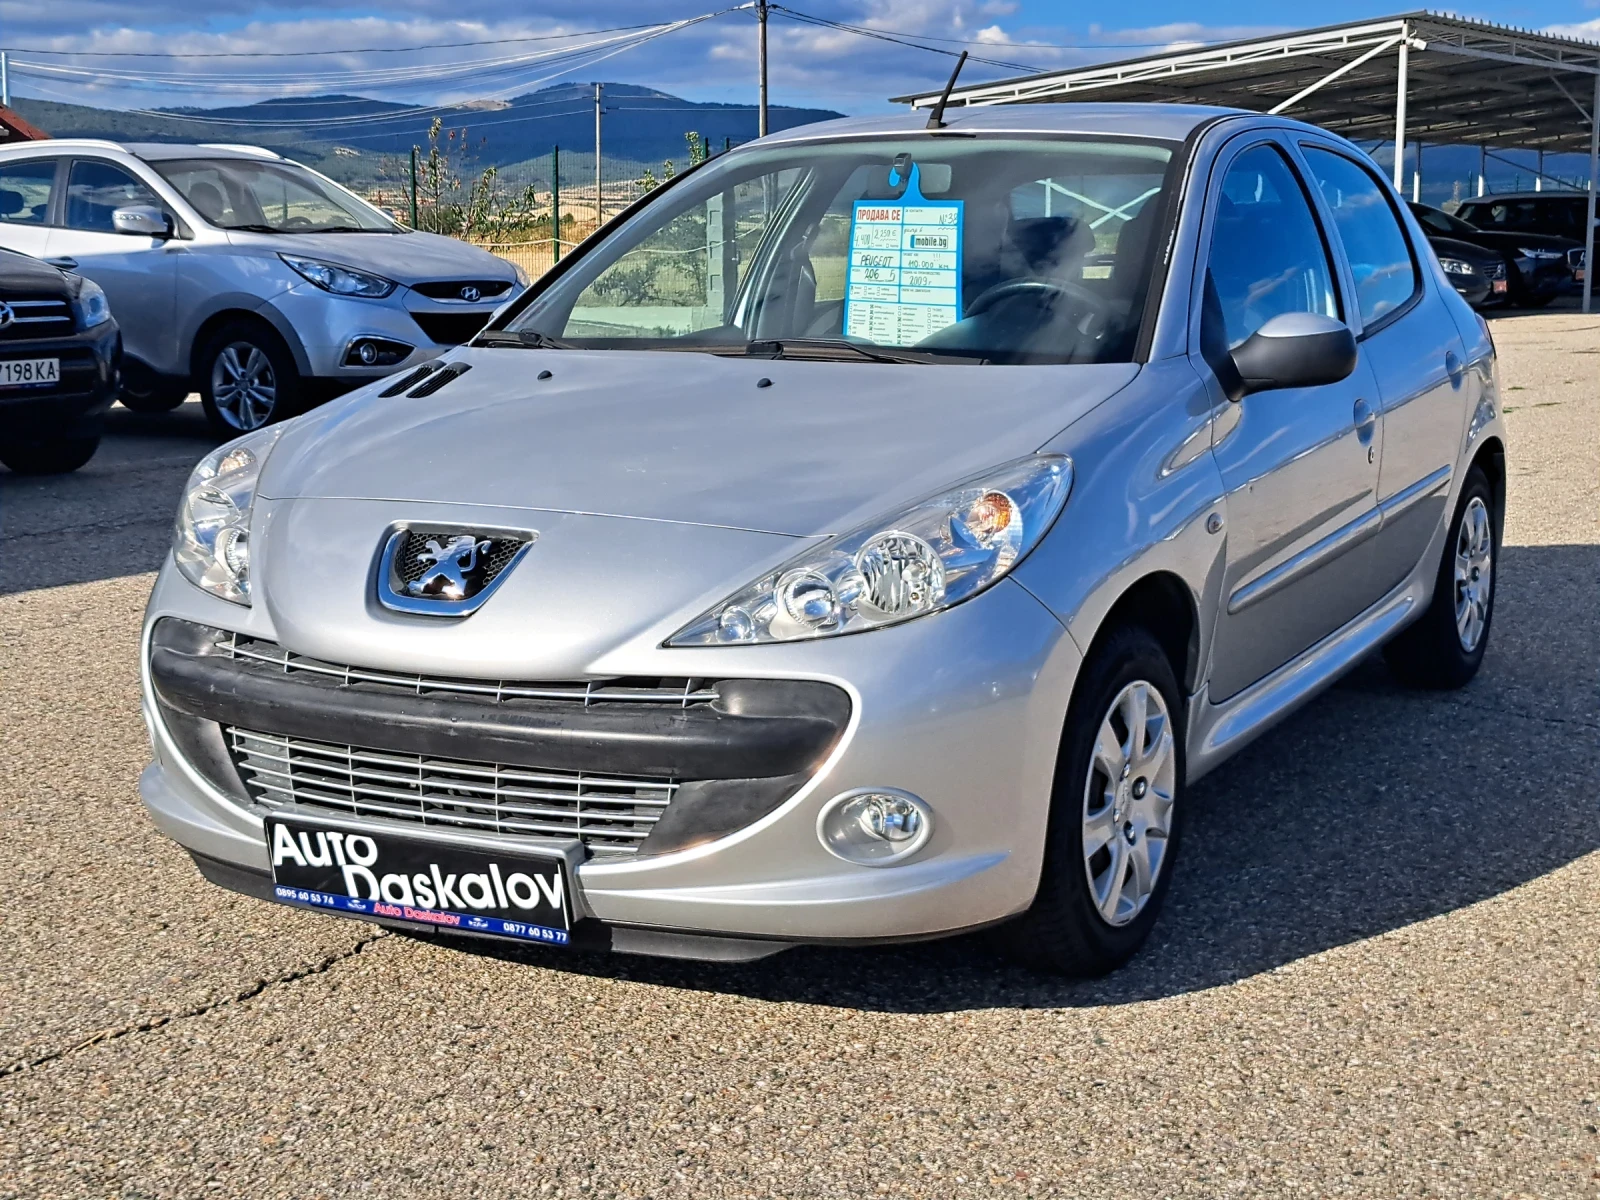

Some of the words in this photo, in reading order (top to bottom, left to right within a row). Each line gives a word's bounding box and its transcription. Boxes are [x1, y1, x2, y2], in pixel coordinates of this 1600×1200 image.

[857, 209, 889, 221] ПРОДАВА
[891, 209, 901, 221] СЕ
[915, 237, 947, 247] mobile.bg
[861, 255, 894, 267] PEUGEOT
[864, 268, 880, 280] 206
[342, 863, 563, 910] Daskalov
[276, 887, 297, 899] 0895
[298, 890, 309, 901] 60
[311, 893, 321, 903] 53
[322, 895, 335, 905] 74
[374, 902, 403, 917] Auto
[404, 906, 461, 925] Daskalov
[503, 922, 526, 934] 0877
[528, 926, 540, 937] 60
[542, 929, 554, 939] 53
[556, 932, 567, 942] 77
